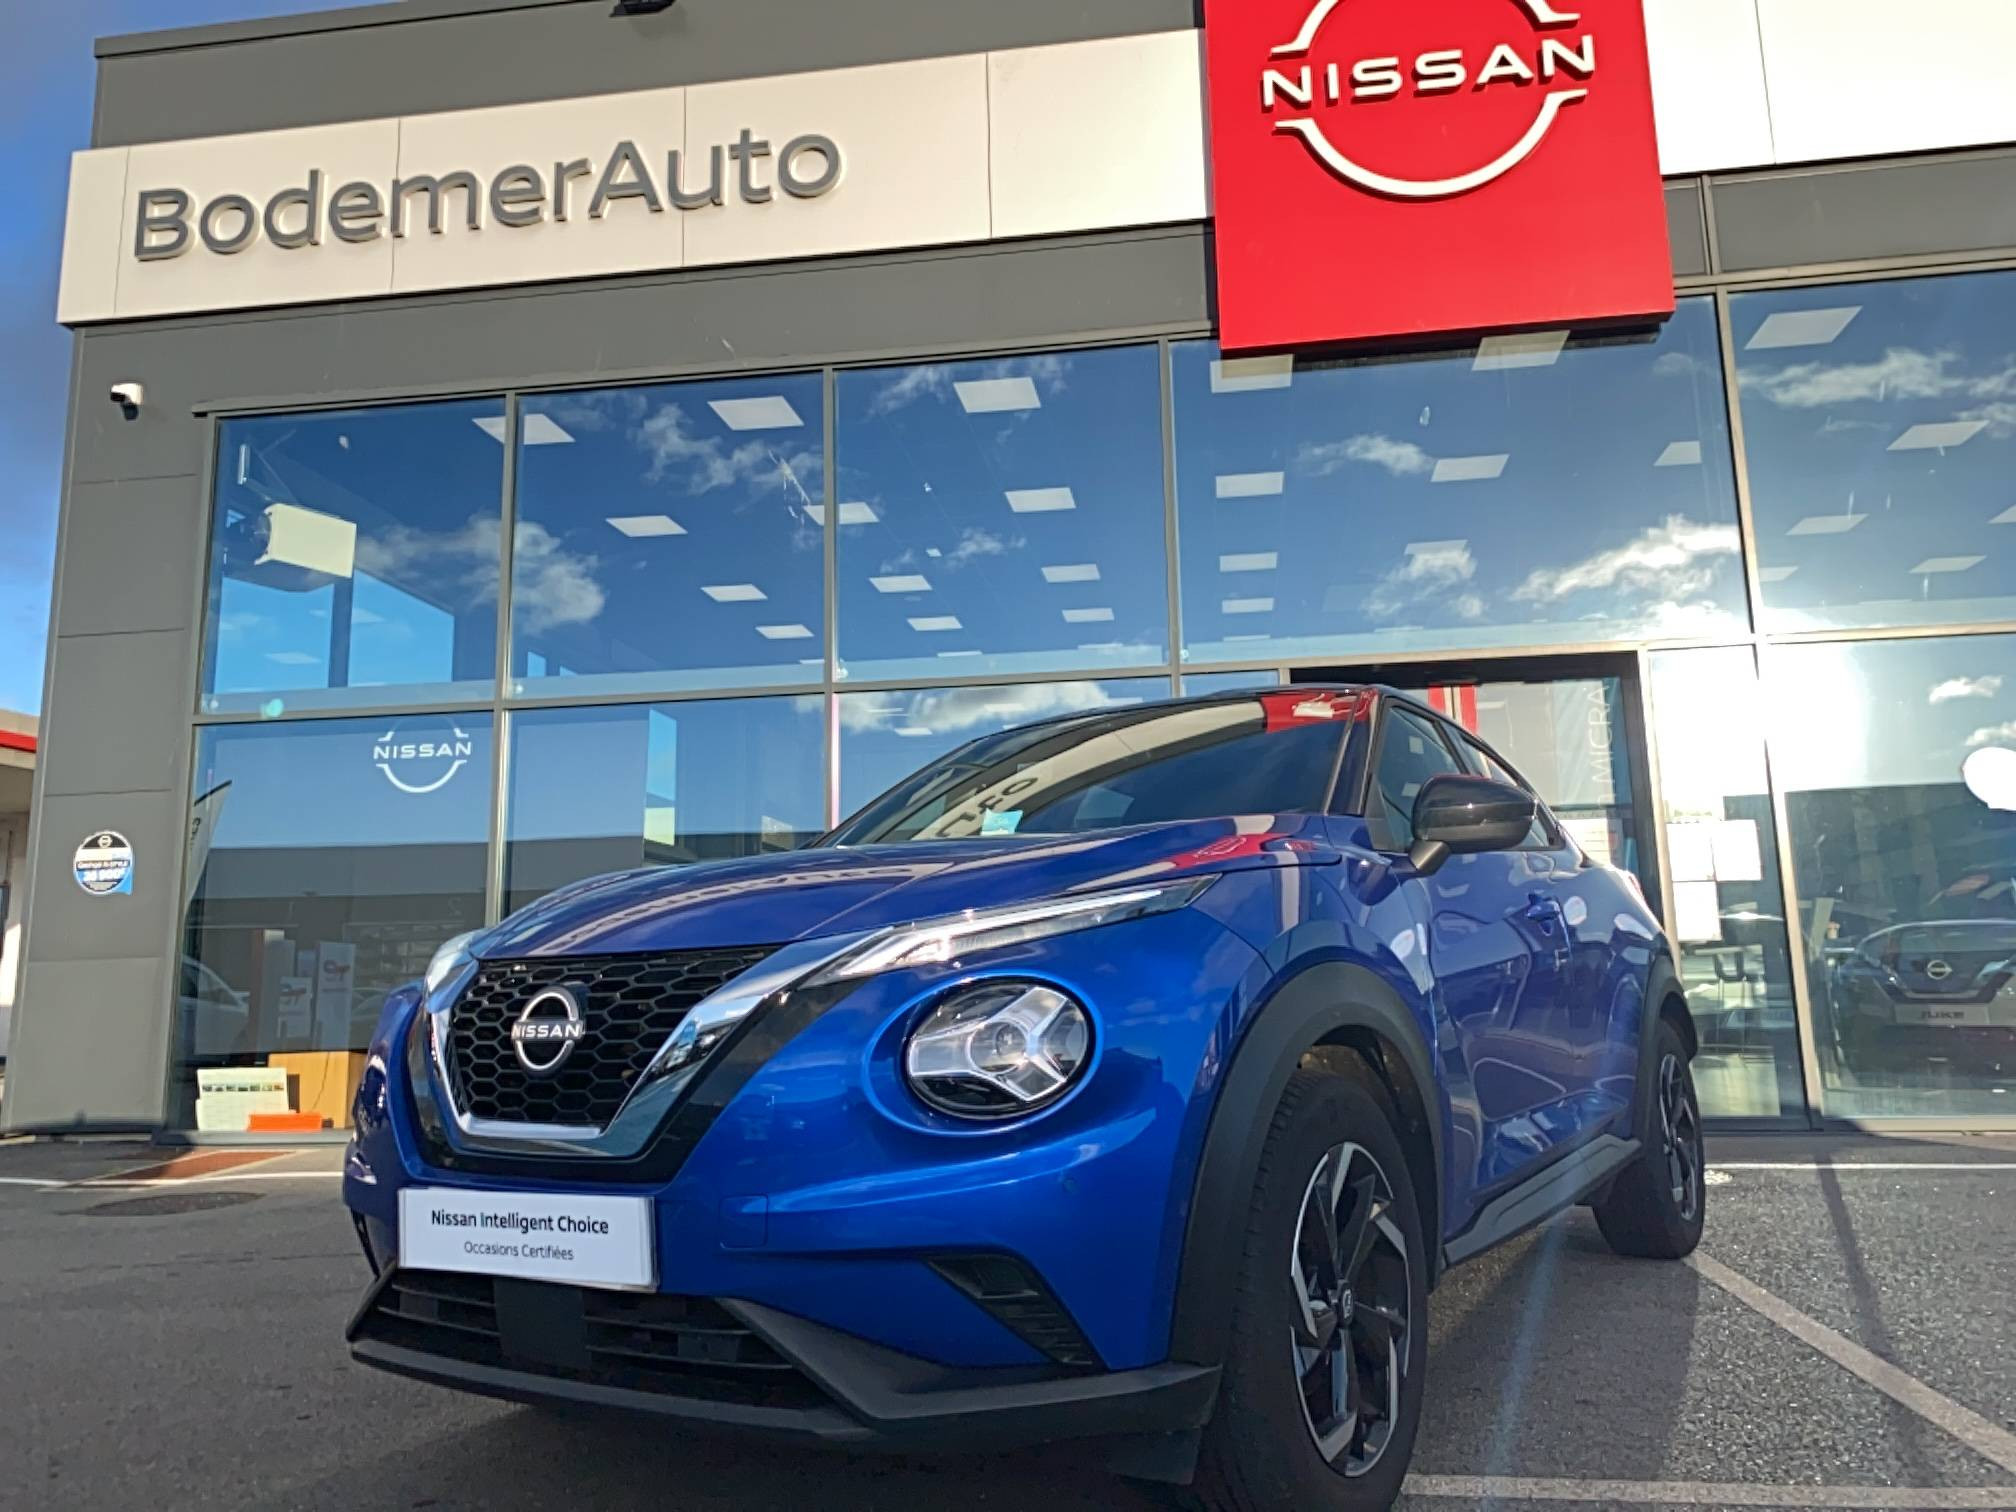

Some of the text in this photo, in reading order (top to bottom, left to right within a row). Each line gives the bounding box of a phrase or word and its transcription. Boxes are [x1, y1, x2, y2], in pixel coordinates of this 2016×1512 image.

[1262, 33, 1596, 112] NISSAN
[133, 127, 845, 262] BodemerAuto
[1586, 684, 1616, 784] MICRA
[373, 741, 472, 760] NISSAN
[511, 1024, 580, 1038] NISSAN
[431, 1209, 610, 1234] Nissan Intelligent Choice
[464, 1240, 574, 1260] Occasions Certifiées
